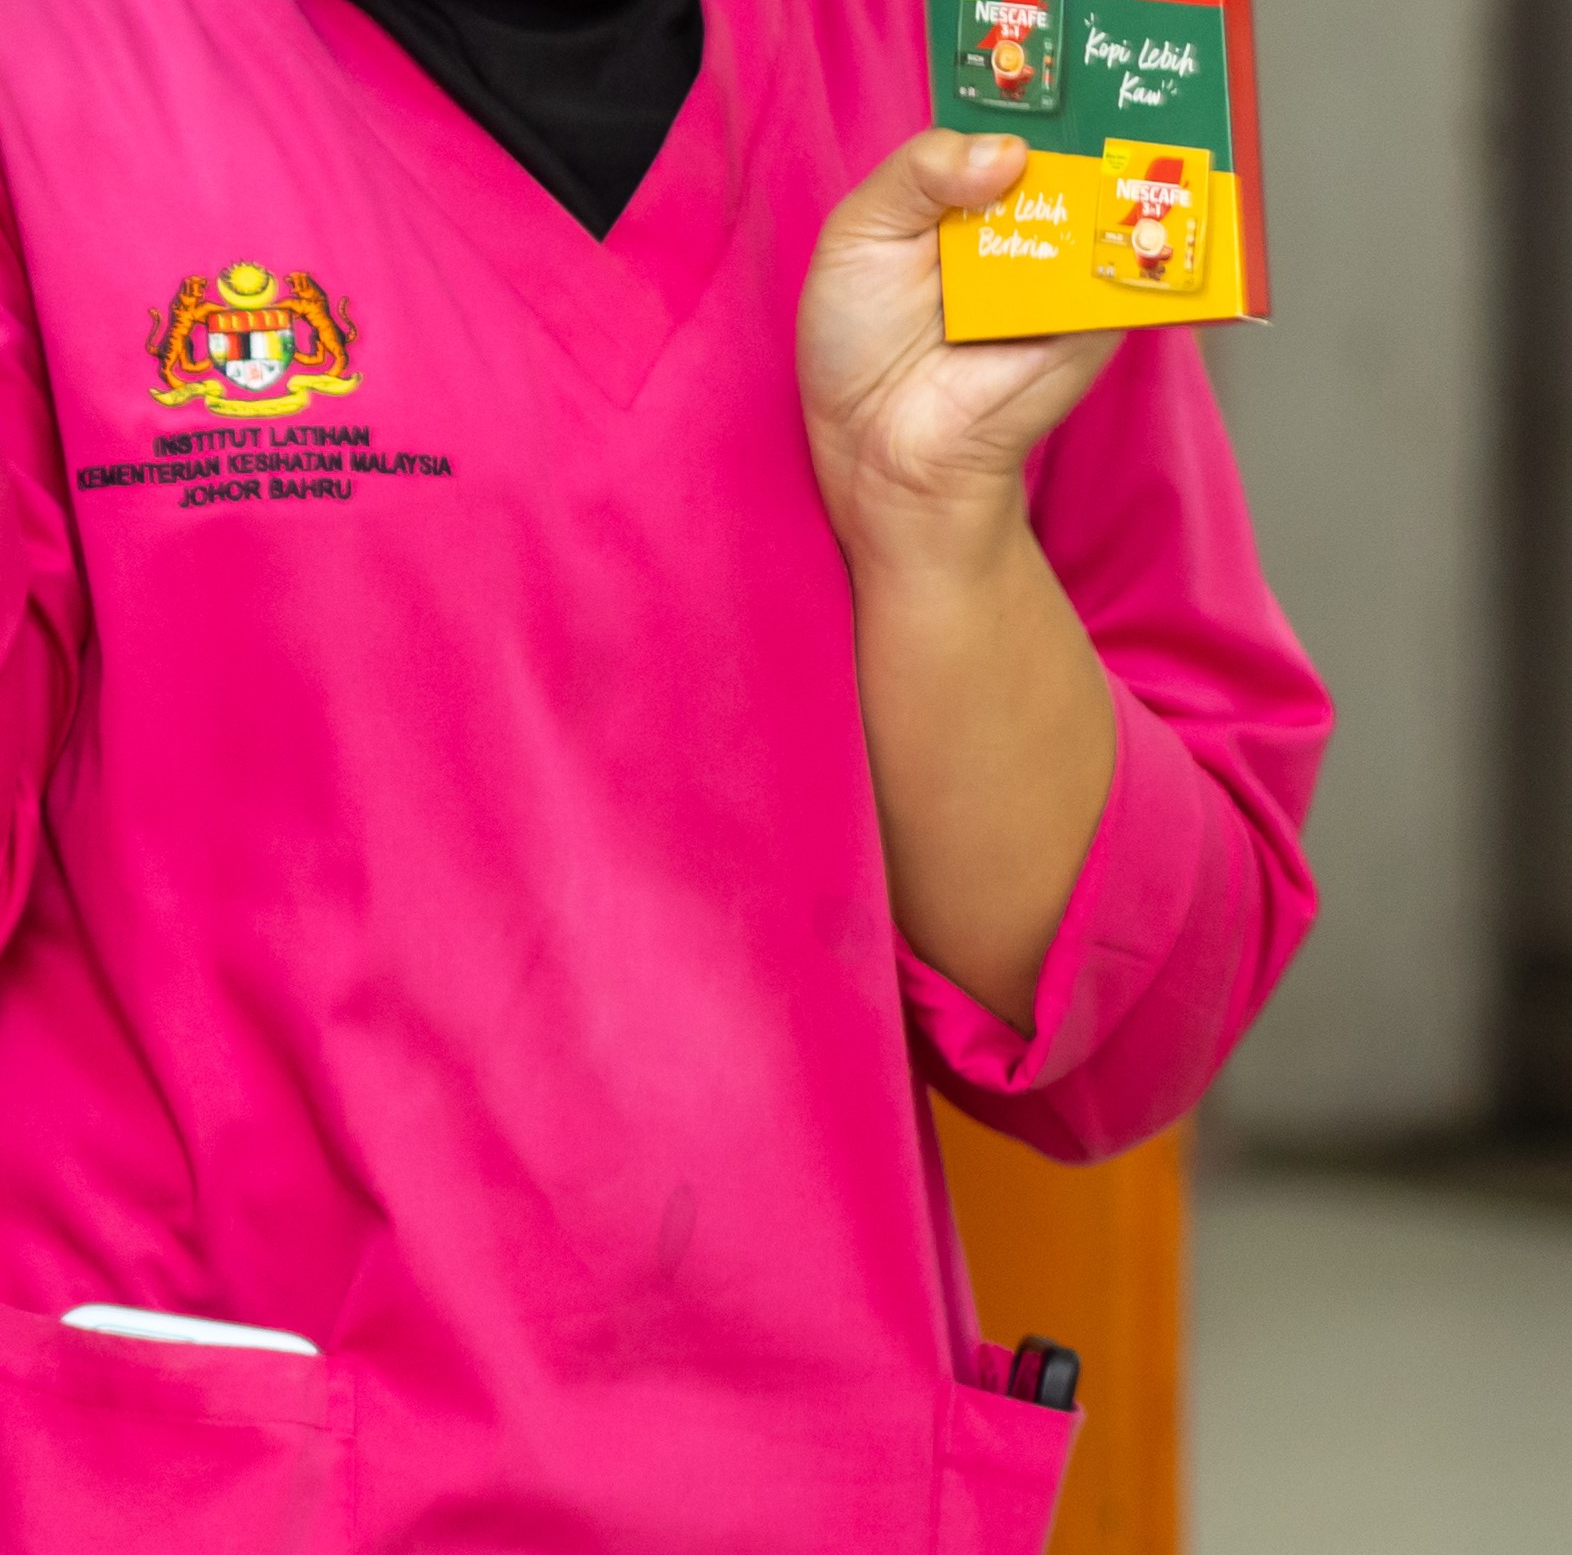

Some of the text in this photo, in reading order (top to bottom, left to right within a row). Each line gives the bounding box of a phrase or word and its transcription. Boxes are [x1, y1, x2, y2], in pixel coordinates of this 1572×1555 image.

[1084, 27, 1197, 77] Kopi Lebih
[1118, 70, 1162, 109] Kaw
[1013, 192, 1069, 226] Lebih
[978, 226, 1059, 260] Berkrim
[153, 425, 371, 456] INSTITUT LATIHAN
[76, 451, 453, 490] KEMENTERIAN KESIHATAN MALAYSIA
[178, 478, 353, 509] JOHOR BAHRU
